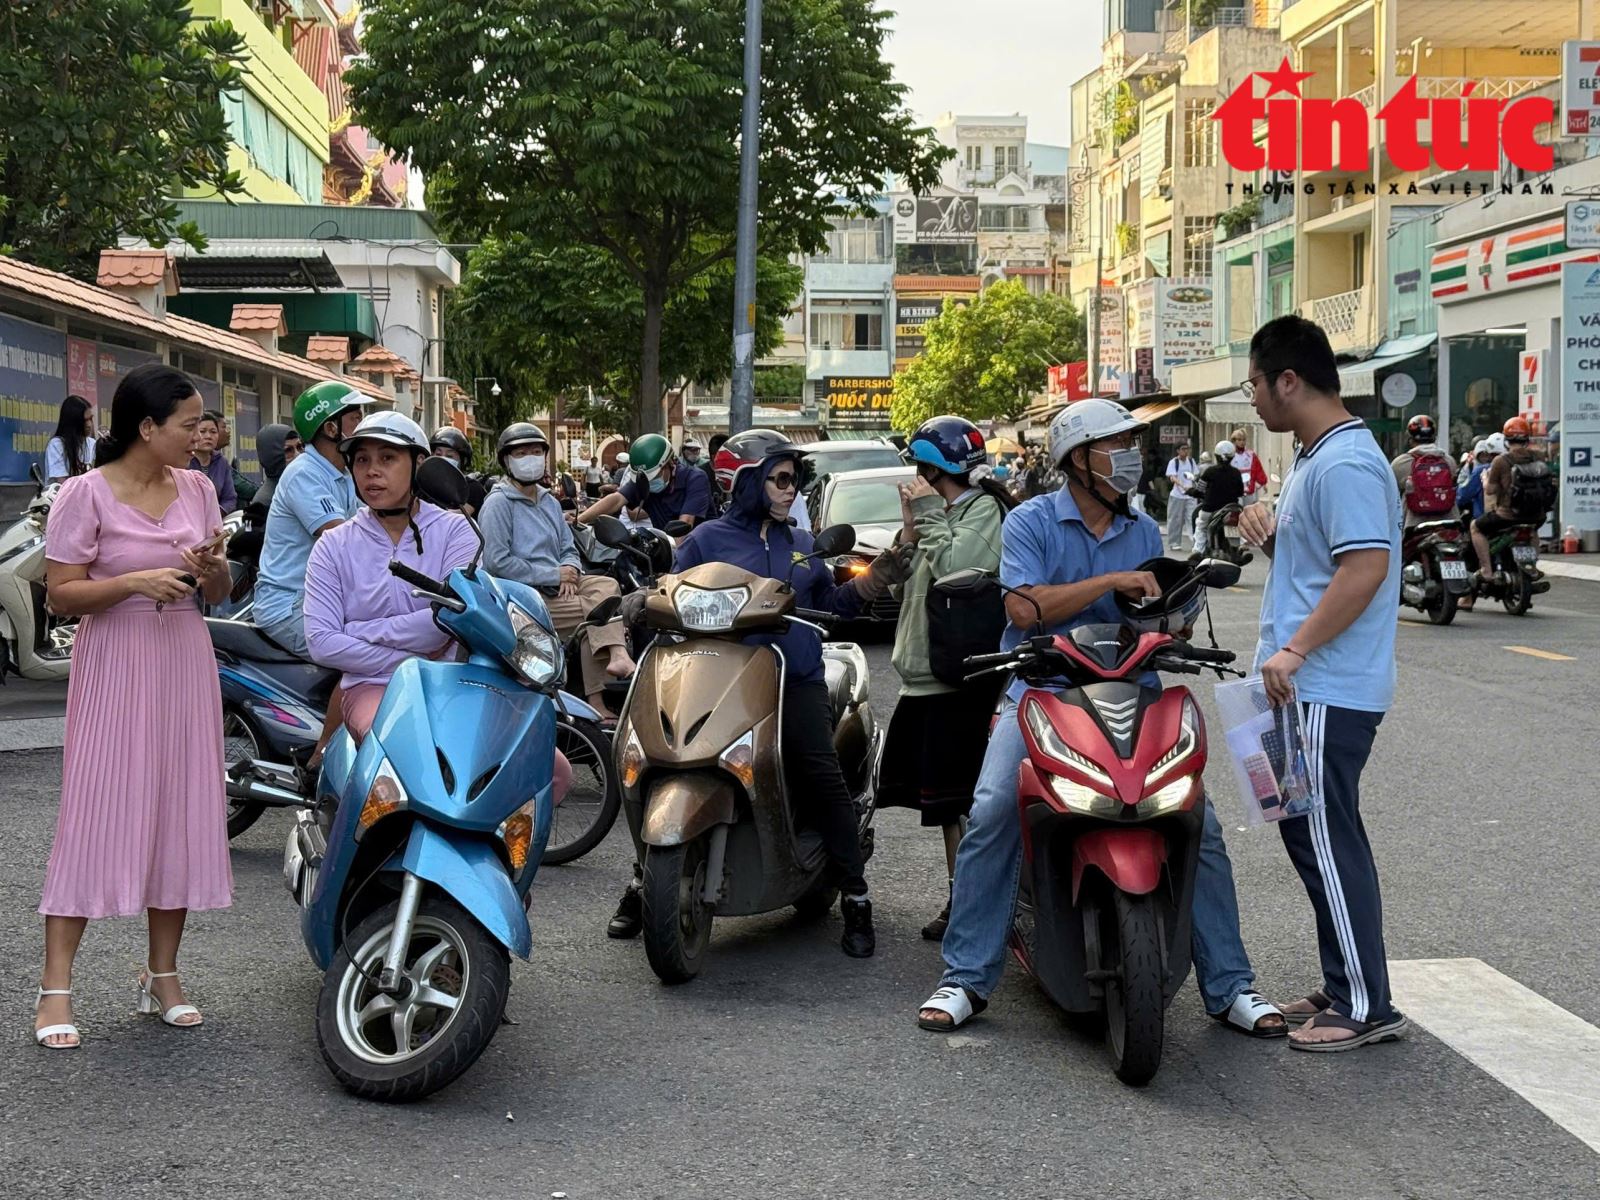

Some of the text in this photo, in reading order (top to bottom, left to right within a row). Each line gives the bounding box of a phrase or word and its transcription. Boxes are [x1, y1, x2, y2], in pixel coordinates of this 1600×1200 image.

[1579, 78, 1600, 89] ELE
[1192, 320, 1213, 328] Sữ
[1138, 350, 1152, 393] HOTEL
[871, 393, 897, 408] DU
[304, 400, 330, 421] Grab
[1574, 450, 1586, 463] P
[1573, 487, 1589, 496] XE
